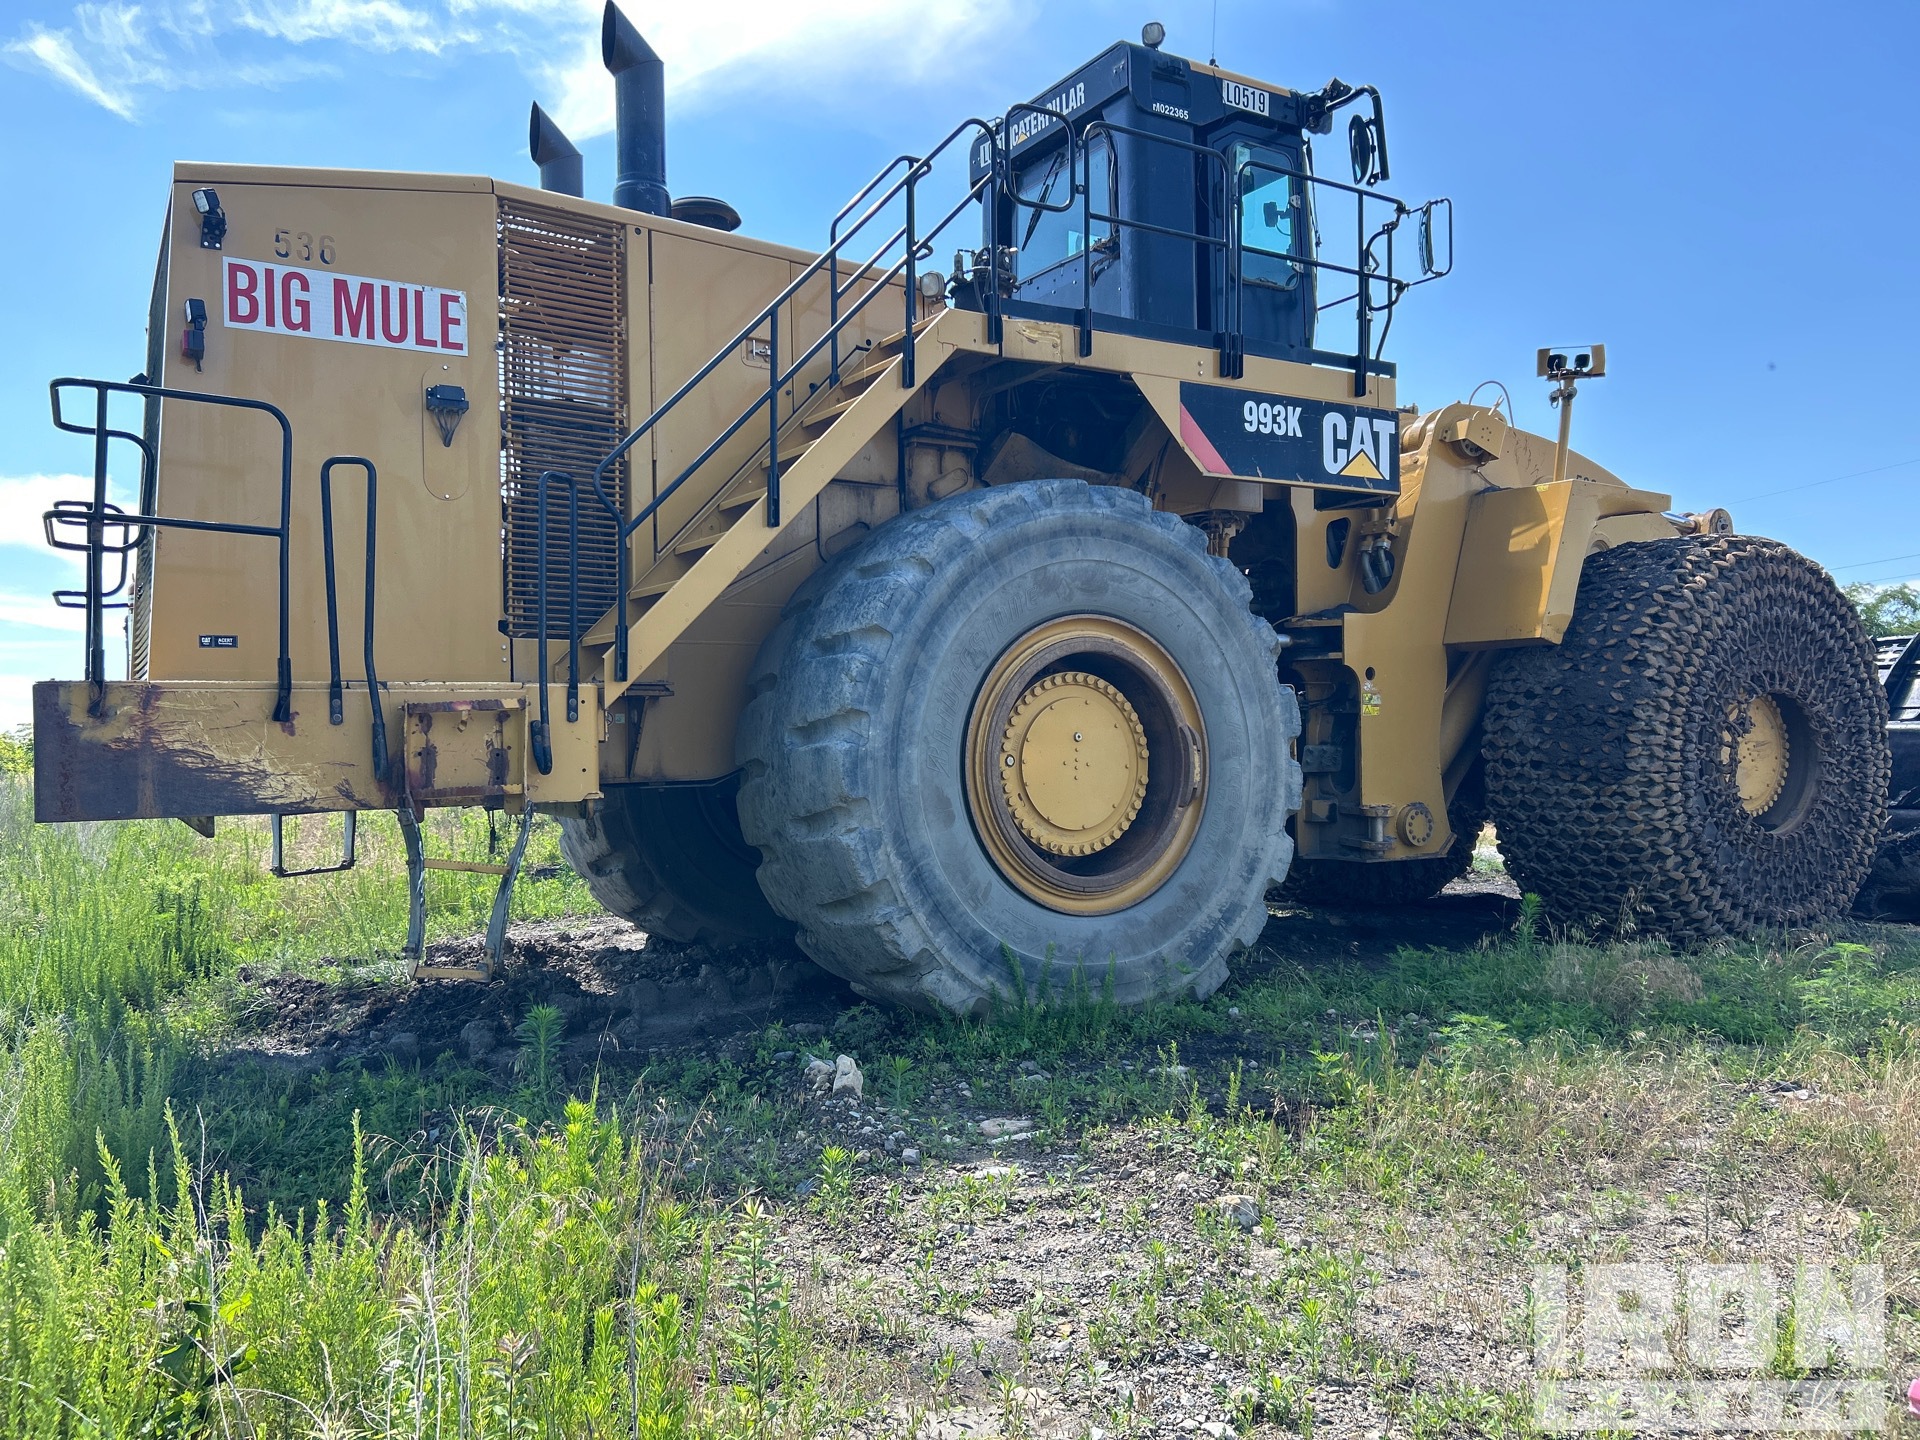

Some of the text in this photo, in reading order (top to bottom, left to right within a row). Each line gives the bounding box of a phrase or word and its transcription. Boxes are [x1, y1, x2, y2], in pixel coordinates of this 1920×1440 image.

[274, 228, 337, 265] 536
[228, 263, 464, 351] BIG MULE
[1243, 400, 1302, 438] 993K
[1323, 412, 1396, 481] CAT
